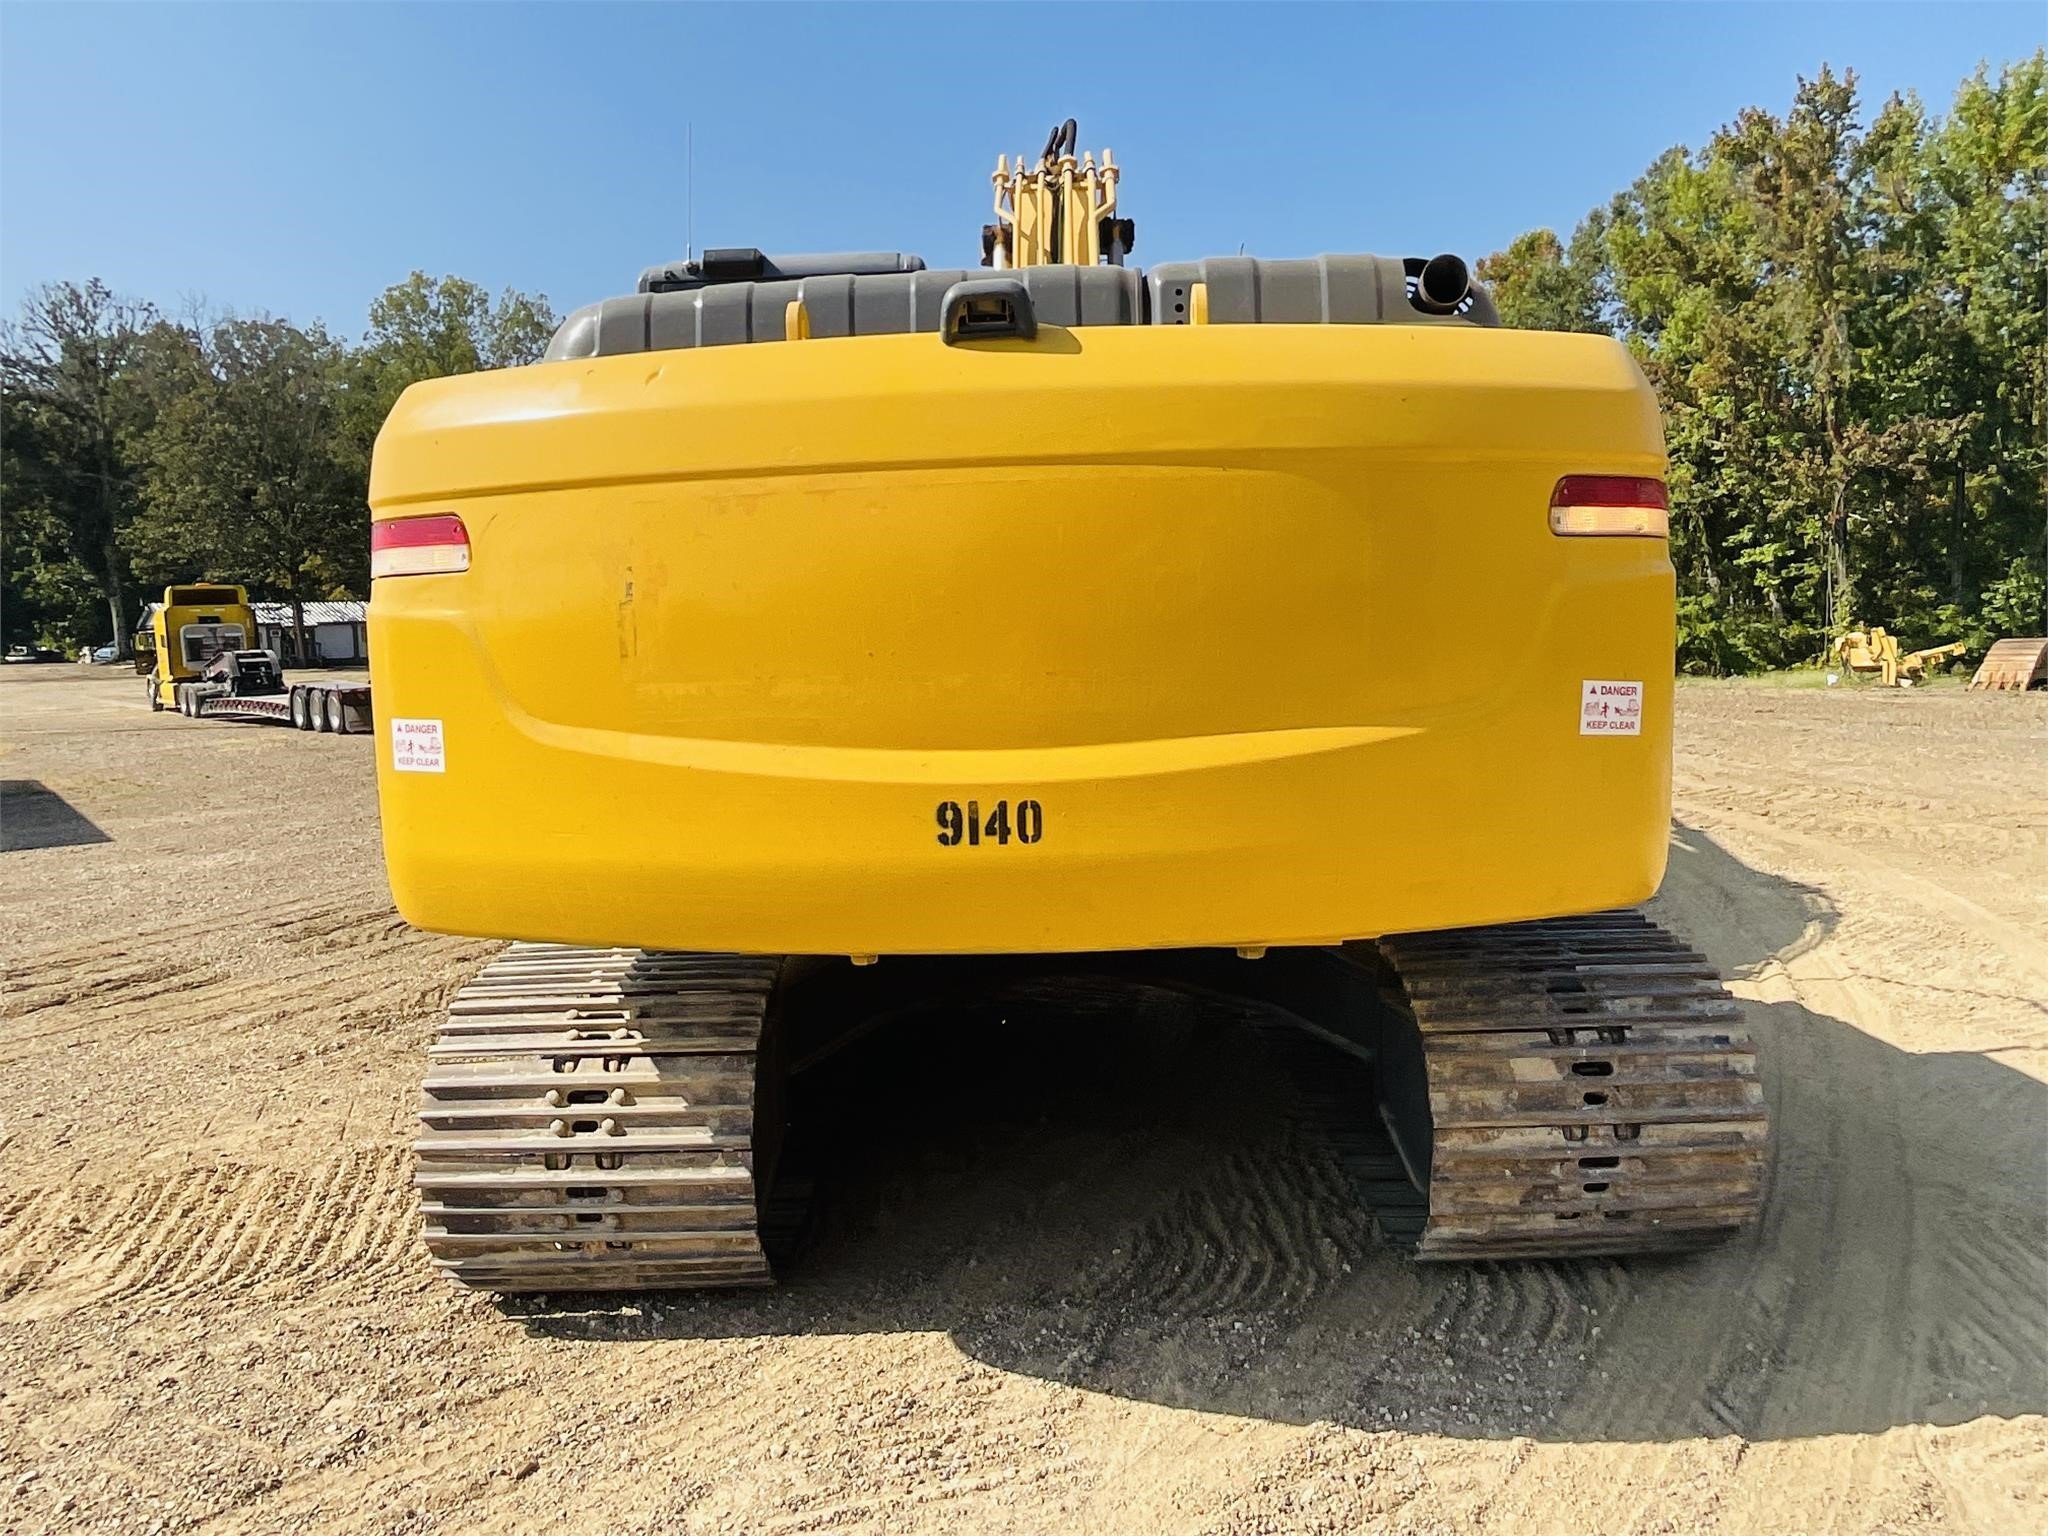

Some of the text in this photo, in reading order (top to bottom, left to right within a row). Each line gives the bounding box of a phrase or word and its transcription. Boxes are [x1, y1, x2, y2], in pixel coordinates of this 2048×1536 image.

[1600, 685, 1637, 696] DANGER
[404, 723, 438, 734] DANGER
[1586, 720, 1635, 730] KEEP CLEAR
[398, 756, 440, 767] KEEP CLEAR
[936, 800, 1043, 846] 9140
